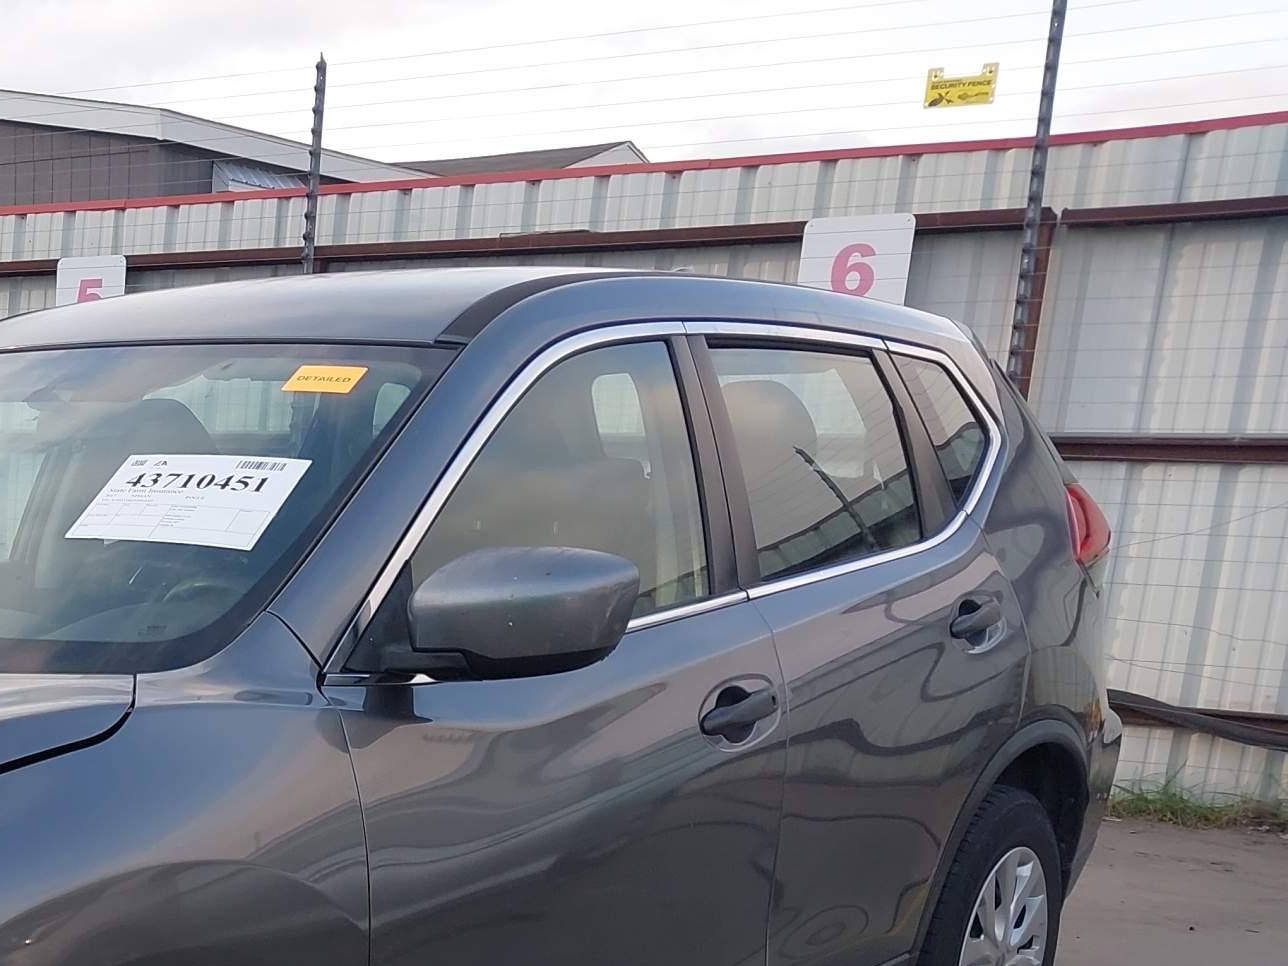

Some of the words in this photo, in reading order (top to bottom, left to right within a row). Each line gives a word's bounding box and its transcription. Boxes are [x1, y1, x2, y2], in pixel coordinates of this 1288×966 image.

[931, 82, 967, 90] SECURITY
[831, 243, 876, 297] 6
[77, 278, 103, 303] 5
[296, 375, 352, 383] DETAILED
[125, 473, 269, 492] 43710451
